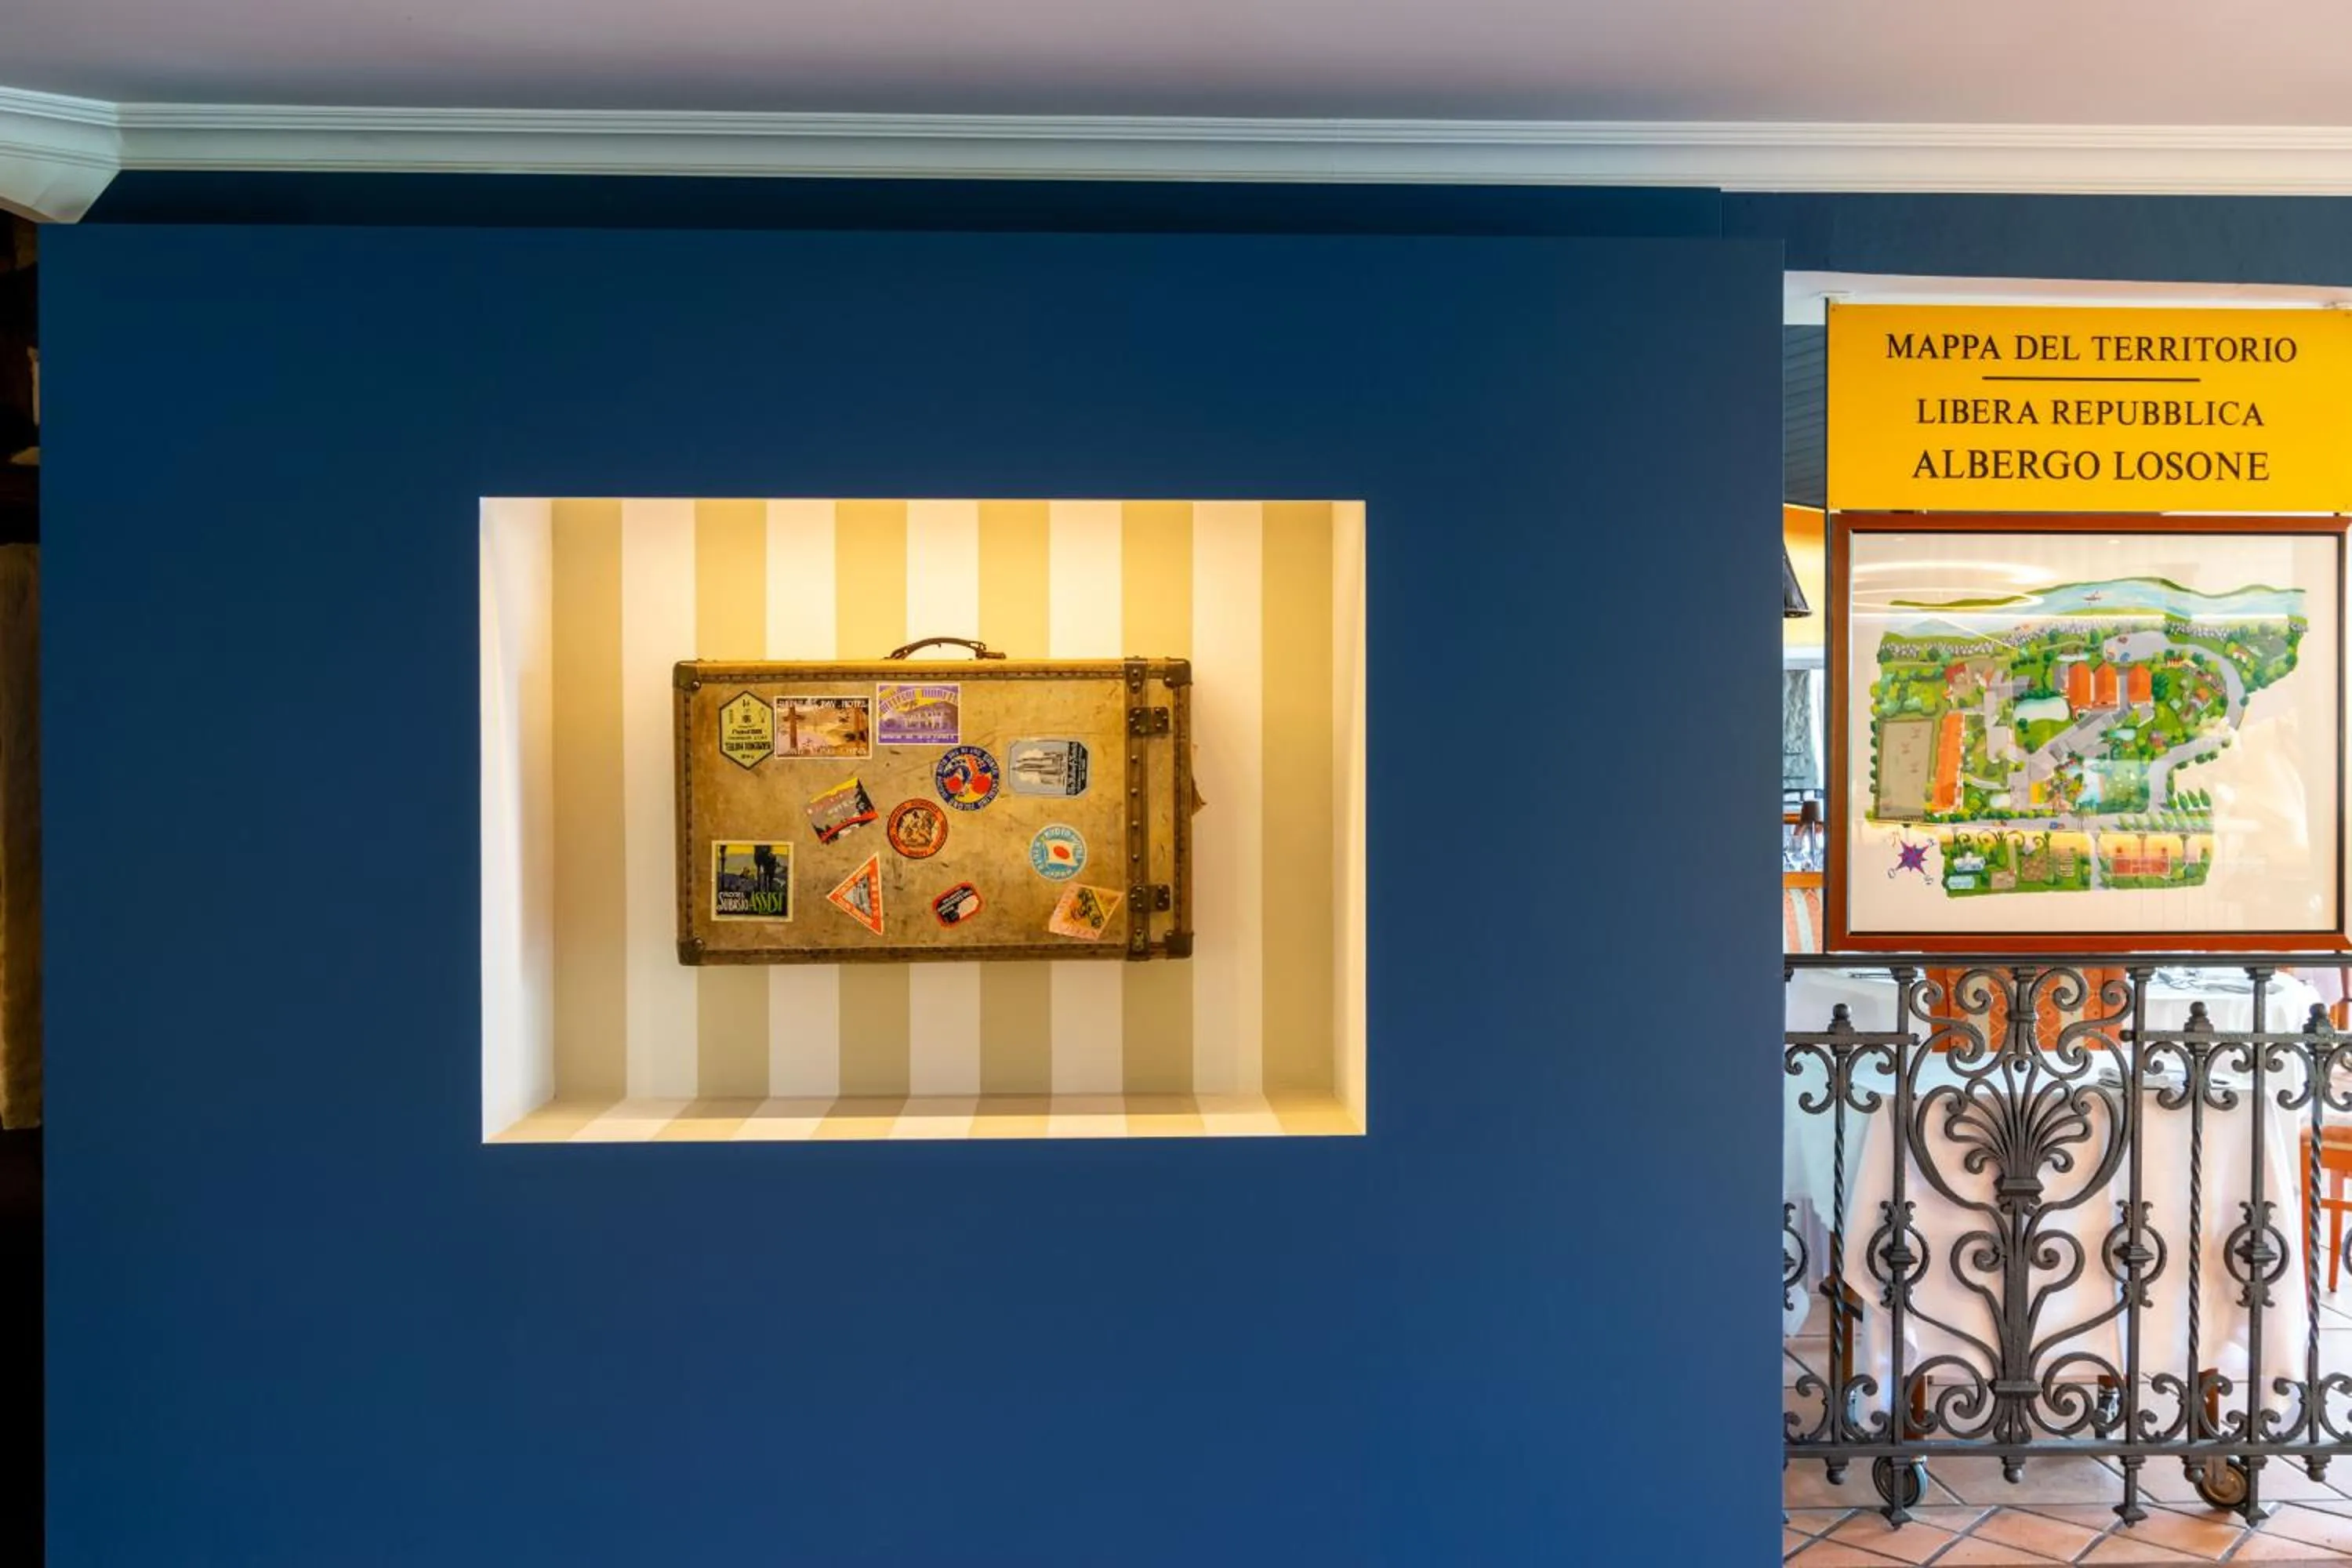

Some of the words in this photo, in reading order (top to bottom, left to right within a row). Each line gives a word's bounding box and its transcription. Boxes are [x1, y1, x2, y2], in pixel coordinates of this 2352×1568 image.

[1886, 333, 2002, 360] MAPPA
[2015, 335, 2080, 361] DEL
[2091, 336, 2298, 362] TERRITORIO
[1917, 398, 2039, 424] LIBERA
[2052, 400, 2264, 426] REPUBBLICA
[1912, 449, 2100, 480] ALBERGO
[2114, 451, 2269, 481] LOSONE
